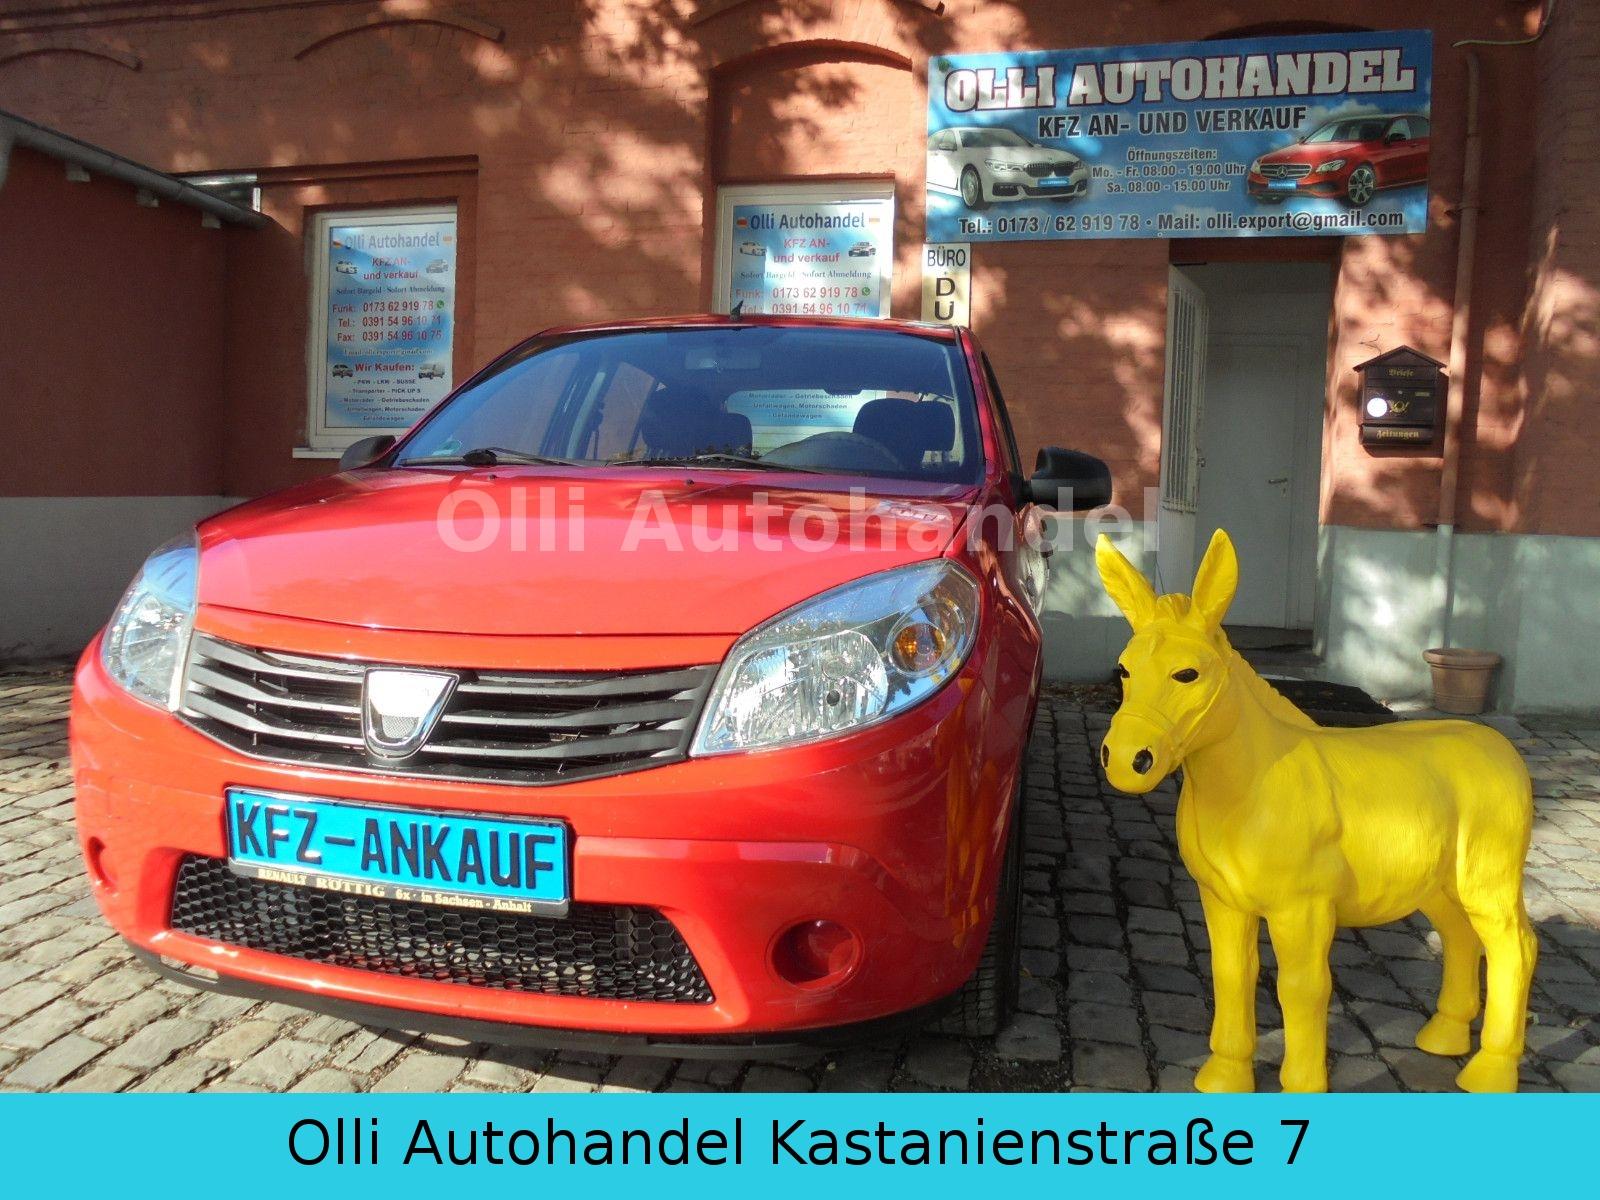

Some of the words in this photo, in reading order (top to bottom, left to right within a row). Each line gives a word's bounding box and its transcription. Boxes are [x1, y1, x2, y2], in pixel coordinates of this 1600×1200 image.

[945, 65, 1056, 112] OLLI
[1067, 47, 1416, 107] AUTOHANDEL
[1038, 114, 1081, 138] KFZ
[1088, 113, 1129, 136] AN-
[1139, 110, 1188, 134] UND
[1196, 106, 1308, 132] VERKAUF
[1127, 147, 1217, 162] Öffnungszeiten:
[1092, 167, 1114, 178] Mo.
[1126, 166, 1139, 177] Fr.
[1189, 164, 1221, 176] 19.00
[1225, 163, 1245, 174] Uhr
[1106, 182, 1125, 193] Sa.
[1128, 181, 1160, 192] 08.00
[1174, 180, 1206, 191] 15.00
[1210, 179, 1230, 190] Uhr
[751, 213, 774, 230] Olli
[779, 212, 865, 229] Autohandel
[959, 217, 992, 234] Tel.:
[998, 216, 1039, 233] 0173
[1055, 215, 1076, 232] 62
[1081, 214, 1113, 231] 919
[1119, 214, 1140, 231] 78
[1158, 212, 1200, 230] Mail:
[1207, 211, 1404, 232] olli.export@gmail.com
[368, 232, 440, 248] Autohandel
[784, 238, 806, 249] KFZ
[809, 238, 830, 249] AN-
[372, 257, 392, 267] KFZ
[774, 254, 794, 263] und
[798, 252, 841, 263] verkauf
[928, 246, 966, 267] BÜRO
[364, 272, 380, 280] und
[384, 270, 418, 279] verkauf
[772, 288, 799, 298] 0173
[803, 288, 816, 298] 62
[820, 287, 840, 298] 919
[845, 287, 858, 297] 78
[363, 302, 385, 312] 0173
[388, 301, 399, 312] 62
[402, 301, 419, 311] 919
[422, 301, 433, 310] 78
[772, 303, 798, 314] 0391
[803, 303, 816, 314] 54
[820, 303, 833, 314] 96
[838, 303, 850, 314] 10
[362, 316, 384, 327] 0391
[388, 316, 399, 327] 54
[402, 316, 413, 326] 96
[337, 332, 355, 342] Fax:
[362, 331, 384, 341] 0391
[388, 331, 399, 341] 54
[402, 331, 413, 340] 96
[417, 331, 427, 340] 10
[355, 363, 372, 372] Wir
[375, 363, 415, 372] Kaufen:
[235, 799, 556, 889] KFZ-ANKAUF
[258, 868, 307, 886] RENAULT
[421, 891, 432, 903] in
[435, 893, 484, 909] Sachsen
[493, 898, 532, 913] Anhalt
